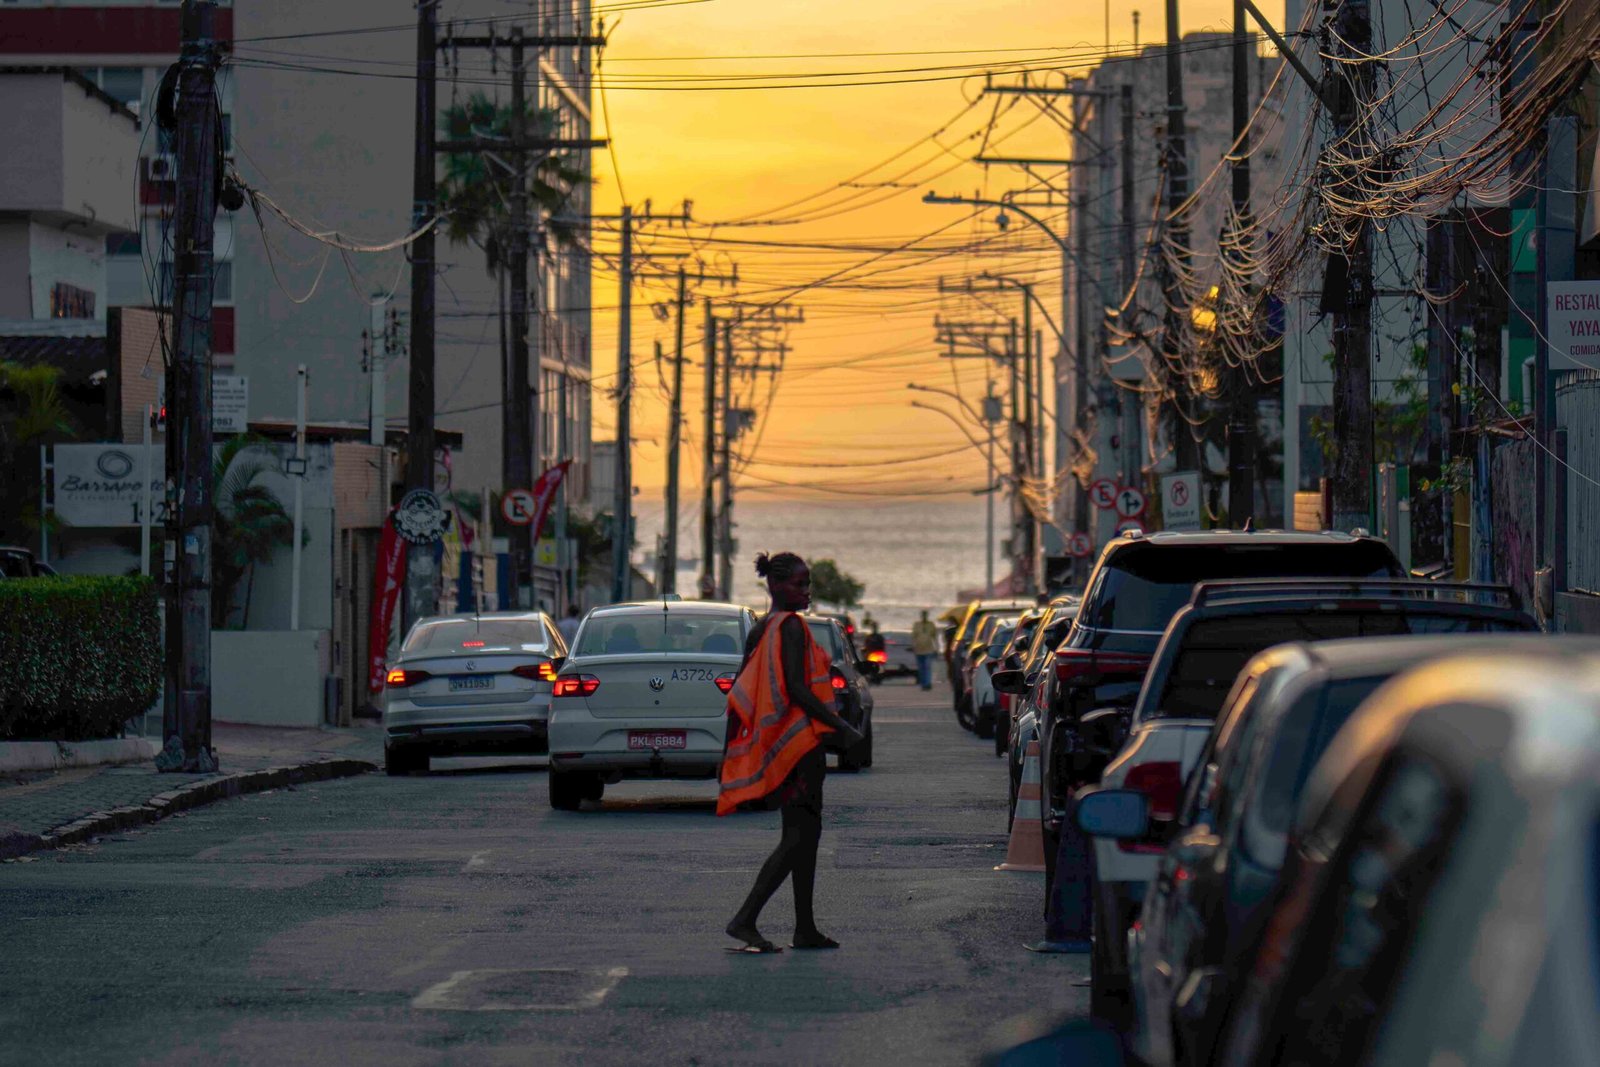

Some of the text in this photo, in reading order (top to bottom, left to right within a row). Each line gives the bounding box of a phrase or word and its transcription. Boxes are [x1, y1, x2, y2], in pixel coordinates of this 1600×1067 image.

[60, 475, 164, 497] Barrapoto
[671, 668, 714, 681] A3726
[630, 736, 652, 746] PKL
